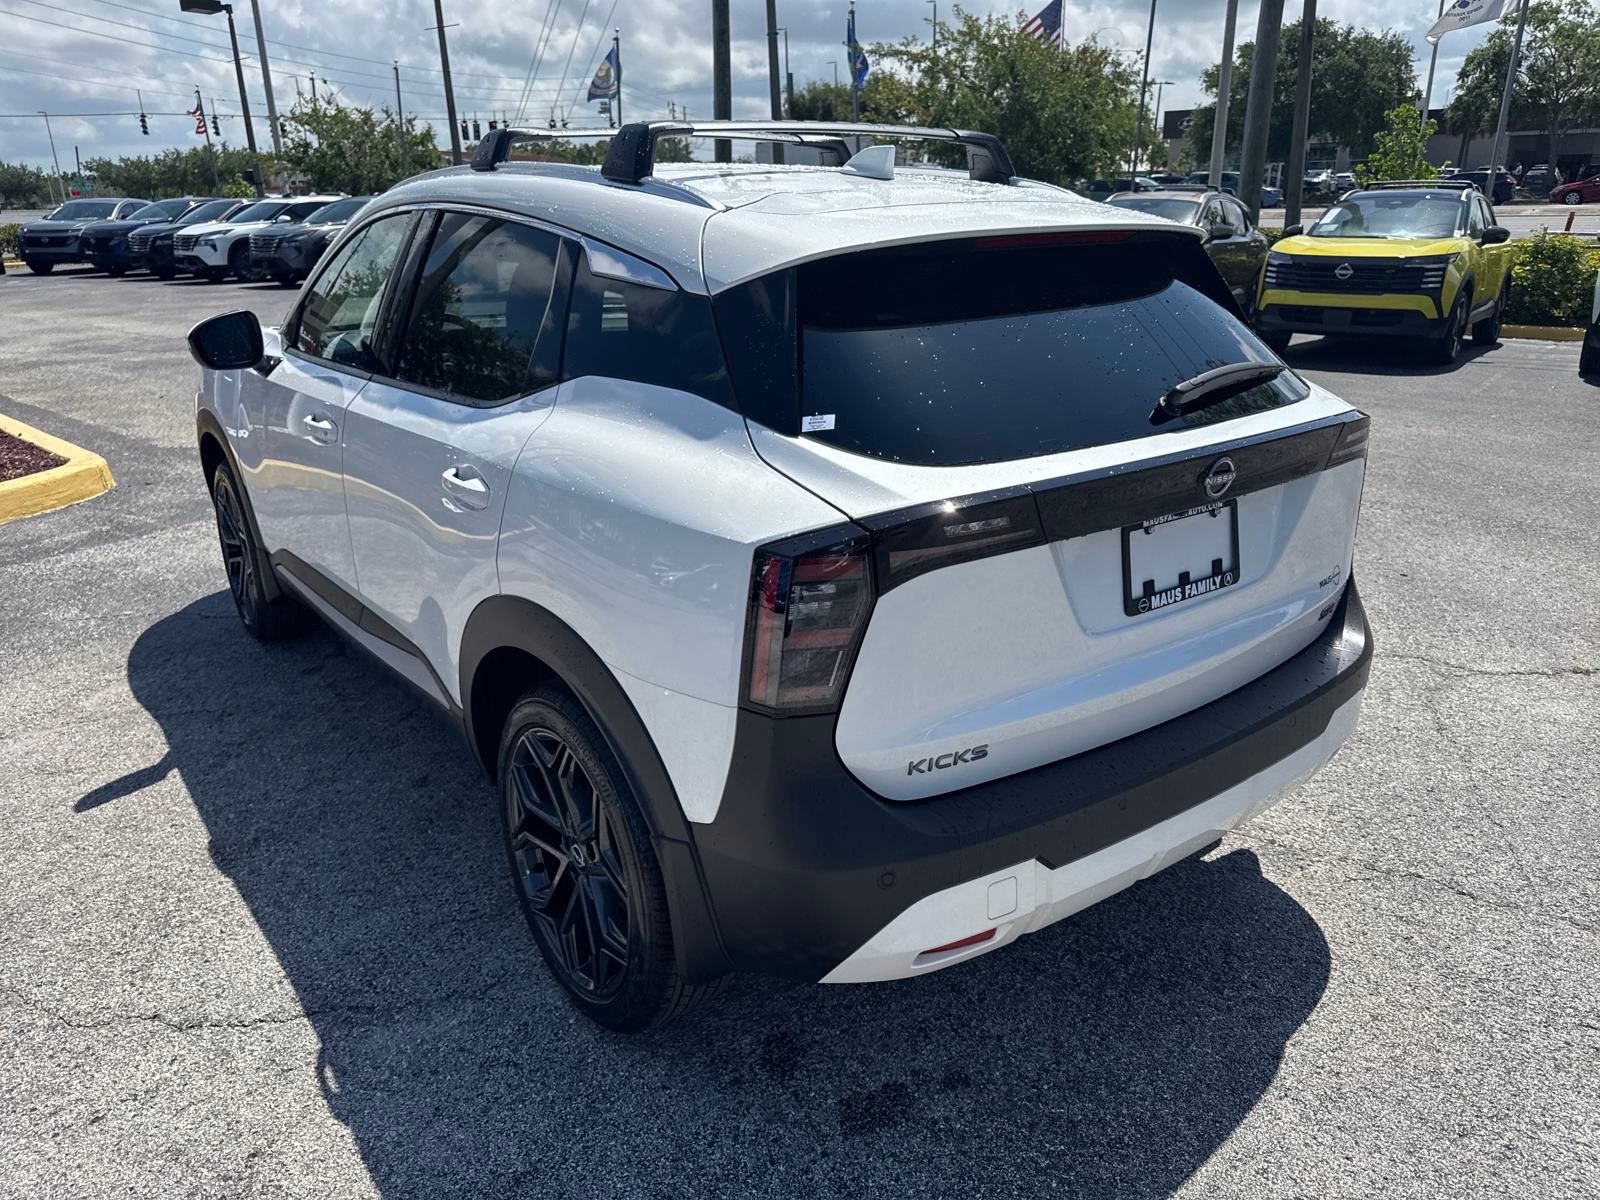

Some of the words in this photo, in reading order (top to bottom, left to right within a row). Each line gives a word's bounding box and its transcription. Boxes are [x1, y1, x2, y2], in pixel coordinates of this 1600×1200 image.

[1151, 587, 1182, 609] MAUS
[1185, 575, 1221, 599] FAMILY
[907, 743, 989, 776] KICKS
